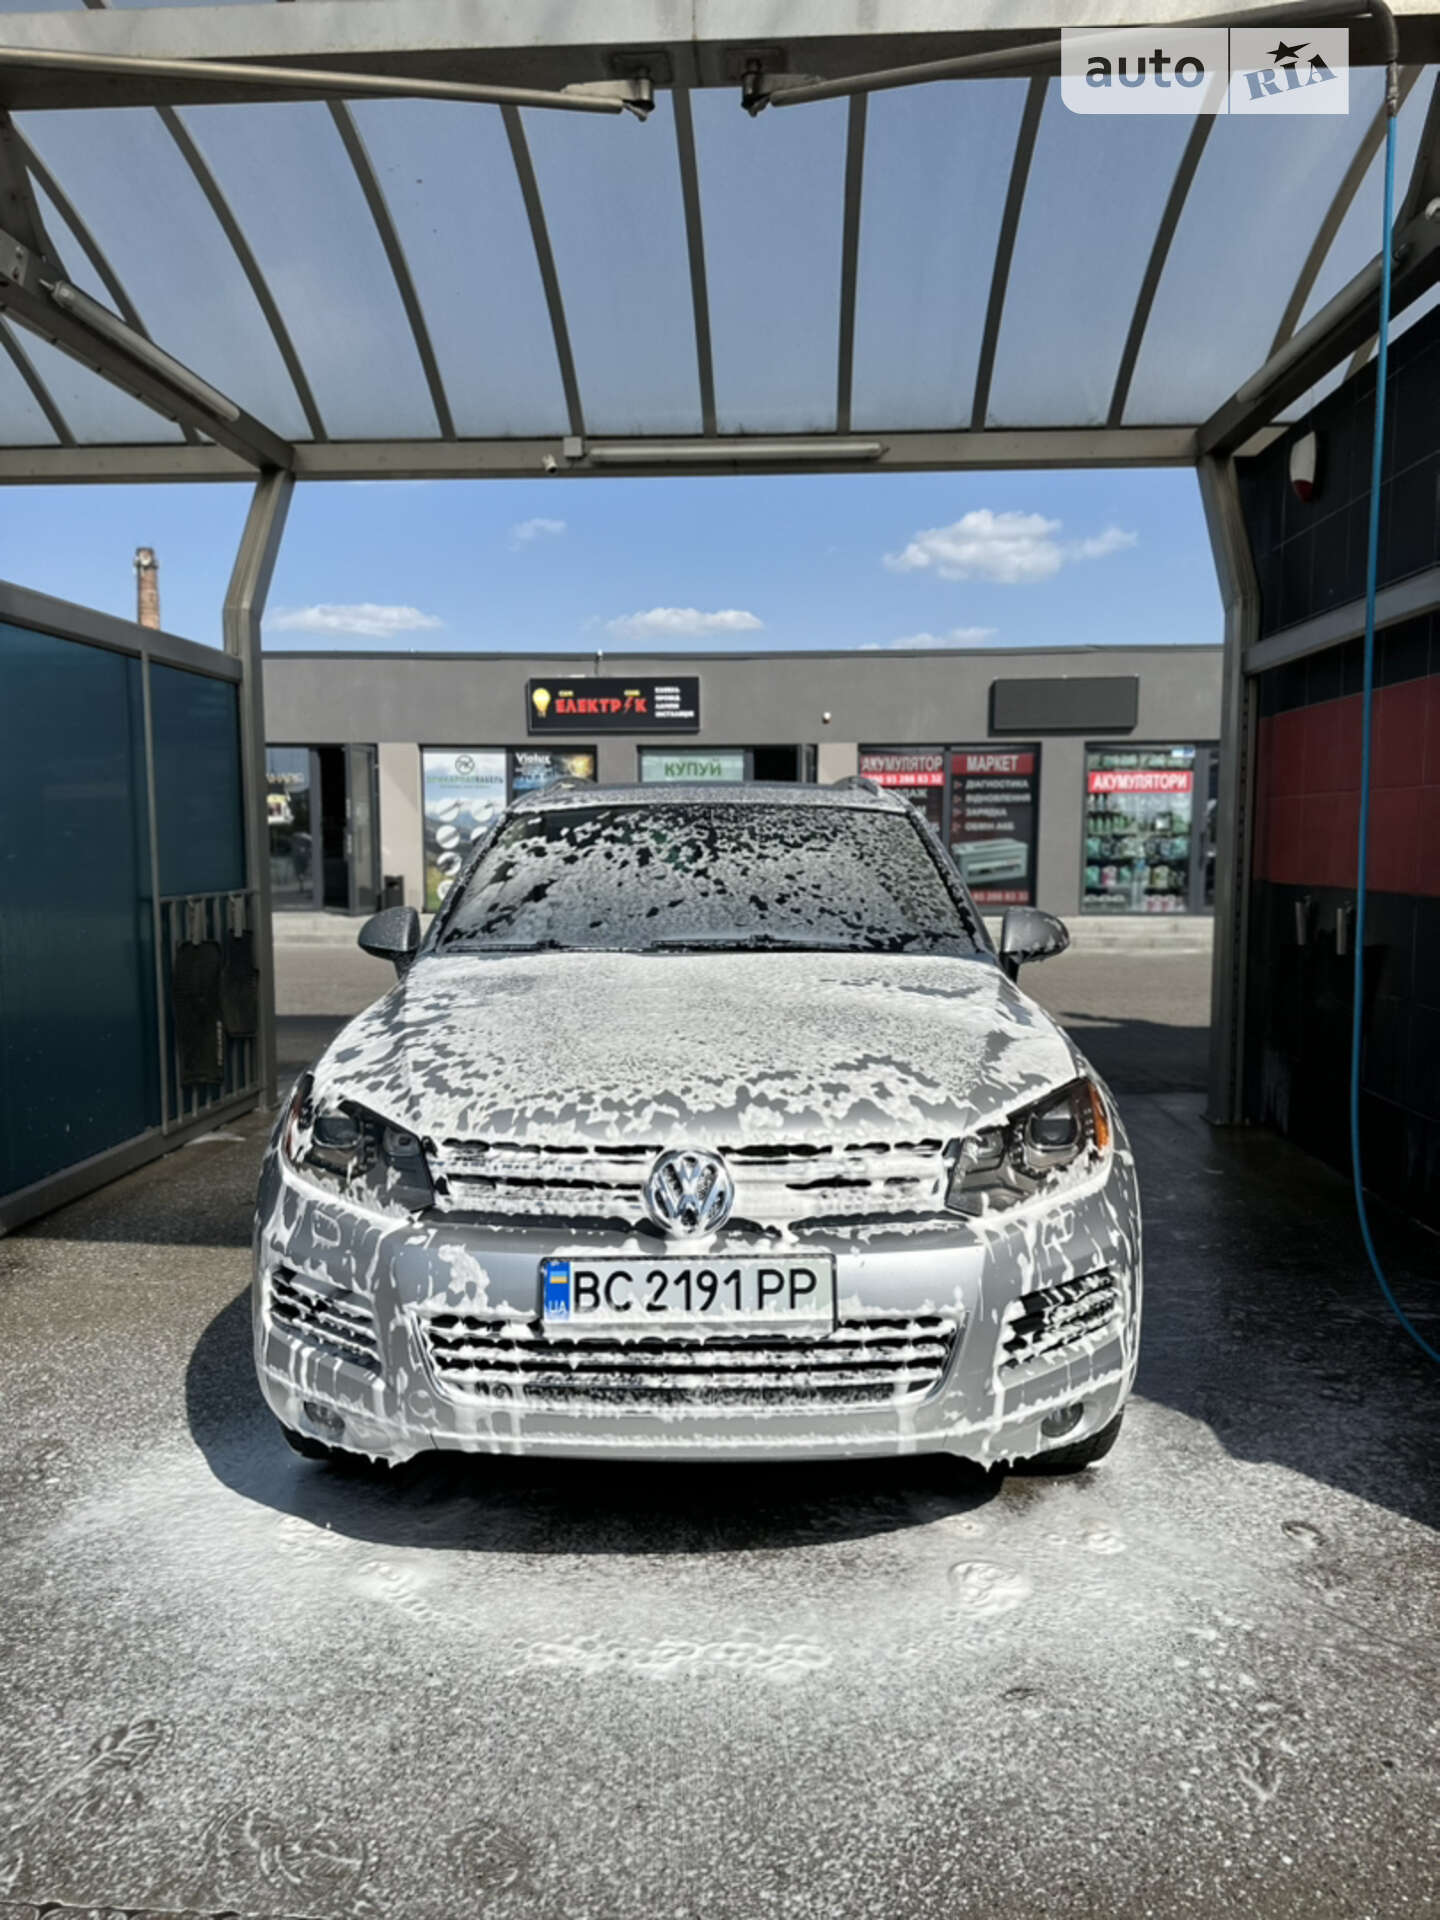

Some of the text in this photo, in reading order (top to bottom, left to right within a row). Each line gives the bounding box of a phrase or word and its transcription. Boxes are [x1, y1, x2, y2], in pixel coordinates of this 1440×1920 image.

[664, 759, 723, 778] КУПУЙ
[861, 755, 944, 772] АКУМУЛЯТОР
[966, 755, 1019, 772] МАРКЕТ
[965, 779, 1030, 789] ДІАГНОСТИКА
[1093, 774, 1188, 789] АКУМУЛЯТОРИ
[574, 1268, 817, 1312] BC 2191 PP
[548, 1299, 567, 1313] UA
